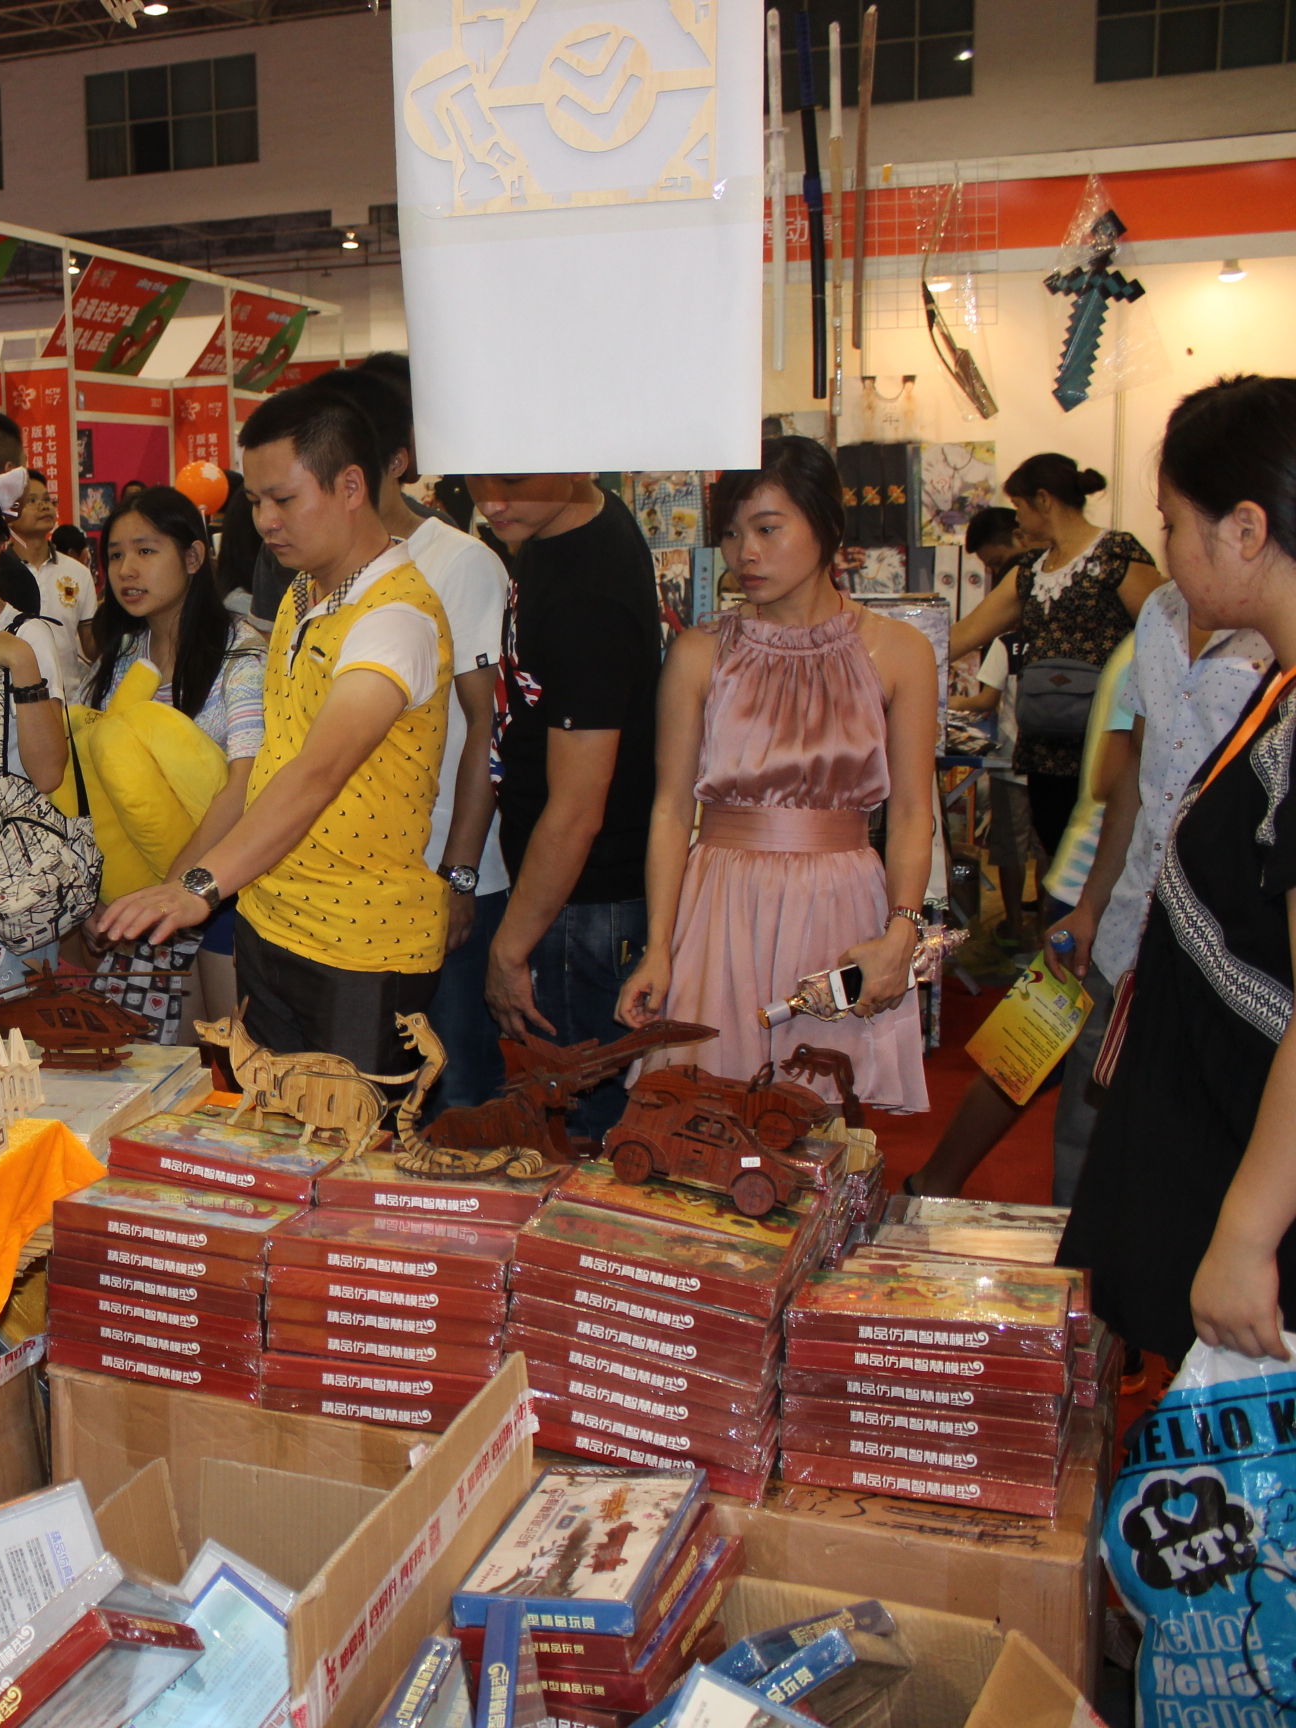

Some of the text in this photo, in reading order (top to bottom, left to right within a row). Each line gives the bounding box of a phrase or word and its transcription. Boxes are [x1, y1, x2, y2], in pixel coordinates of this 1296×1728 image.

[160, 1157, 255, 1187] 精品仿真智慧模型
[375, 1193, 479, 1212] 精品仿真智慧模型
[108, 1221, 207, 1247] 精品仿真智慧模型
[107, 1250, 206, 1277] 精品仿真智慧模型
[327, 1253, 437, 1277] 精品仿真智慧模型
[579, 1254, 700, 1292] 精品仿真智慧模型
[100, 1274, 197, 1301] 精品仿真智慧模型
[329, 1284, 439, 1309] 精品仿真智慧模型
[99, 1300, 198, 1328] 精品仿真智慧模型
[327, 1310, 436, 1334] 精品仿真智慧模型
[574, 1289, 694, 1329] 精品仿真智慧模型
[100, 1327, 200, 1356] 精品仿真智慧模型
[327, 1338, 437, 1362] 精品仿真智慧模型
[576, 1321, 697, 1361] 精品仿真智慧模型
[859, 1326, 989, 1348] 精品仿真智慧模型
[102, 1355, 201, 1384] 精品仿真智慧模型
[568, 1350, 687, 1392] 精品仿真智慧模型
[854, 1351, 984, 1377] 精品仿真智慧模型
[322, 1373, 433, 1395] 精品仿真智慧模型
[847, 1381, 974, 1407] 精品仿真智慧模型
[322, 1401, 432, 1425] 精品仿真智慧模型
[569, 1381, 688, 1421] 精品仿真智慧模型
[571, 1410, 690, 1451] 精品仿真智慧模型
[850, 1410, 978, 1437] 精品仿真智慧模型
[850, 1440, 977, 1470] 精品仿真智慧模型
[853, 1472, 980, 1500] 精品仿真智慧模型
[1159, 1524, 1245, 1580] KT!
